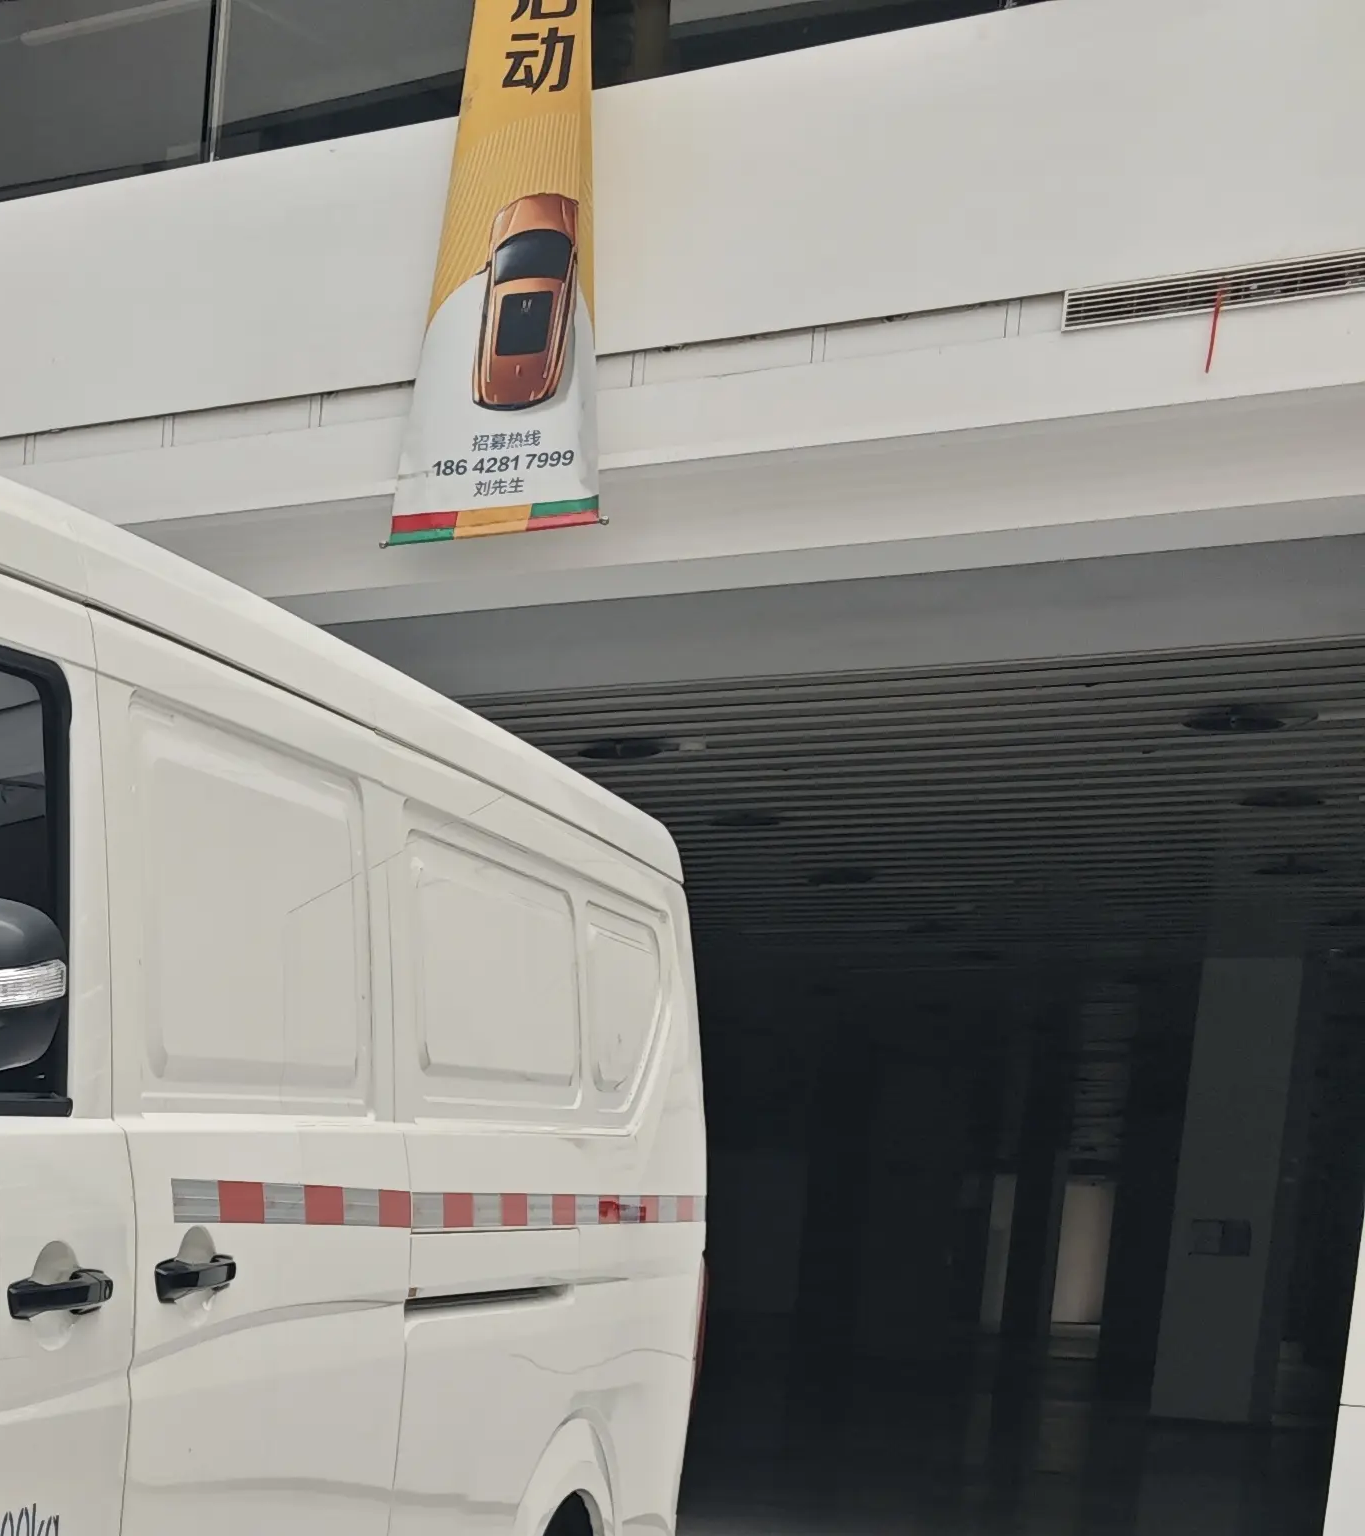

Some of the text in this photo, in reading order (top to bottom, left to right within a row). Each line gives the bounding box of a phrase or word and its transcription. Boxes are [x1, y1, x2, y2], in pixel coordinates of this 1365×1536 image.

[471, 429, 542, 452] 招募热线
[432, 449, 575, 477] 186 4281 7999
[473, 477, 525, 497] 刘先生
